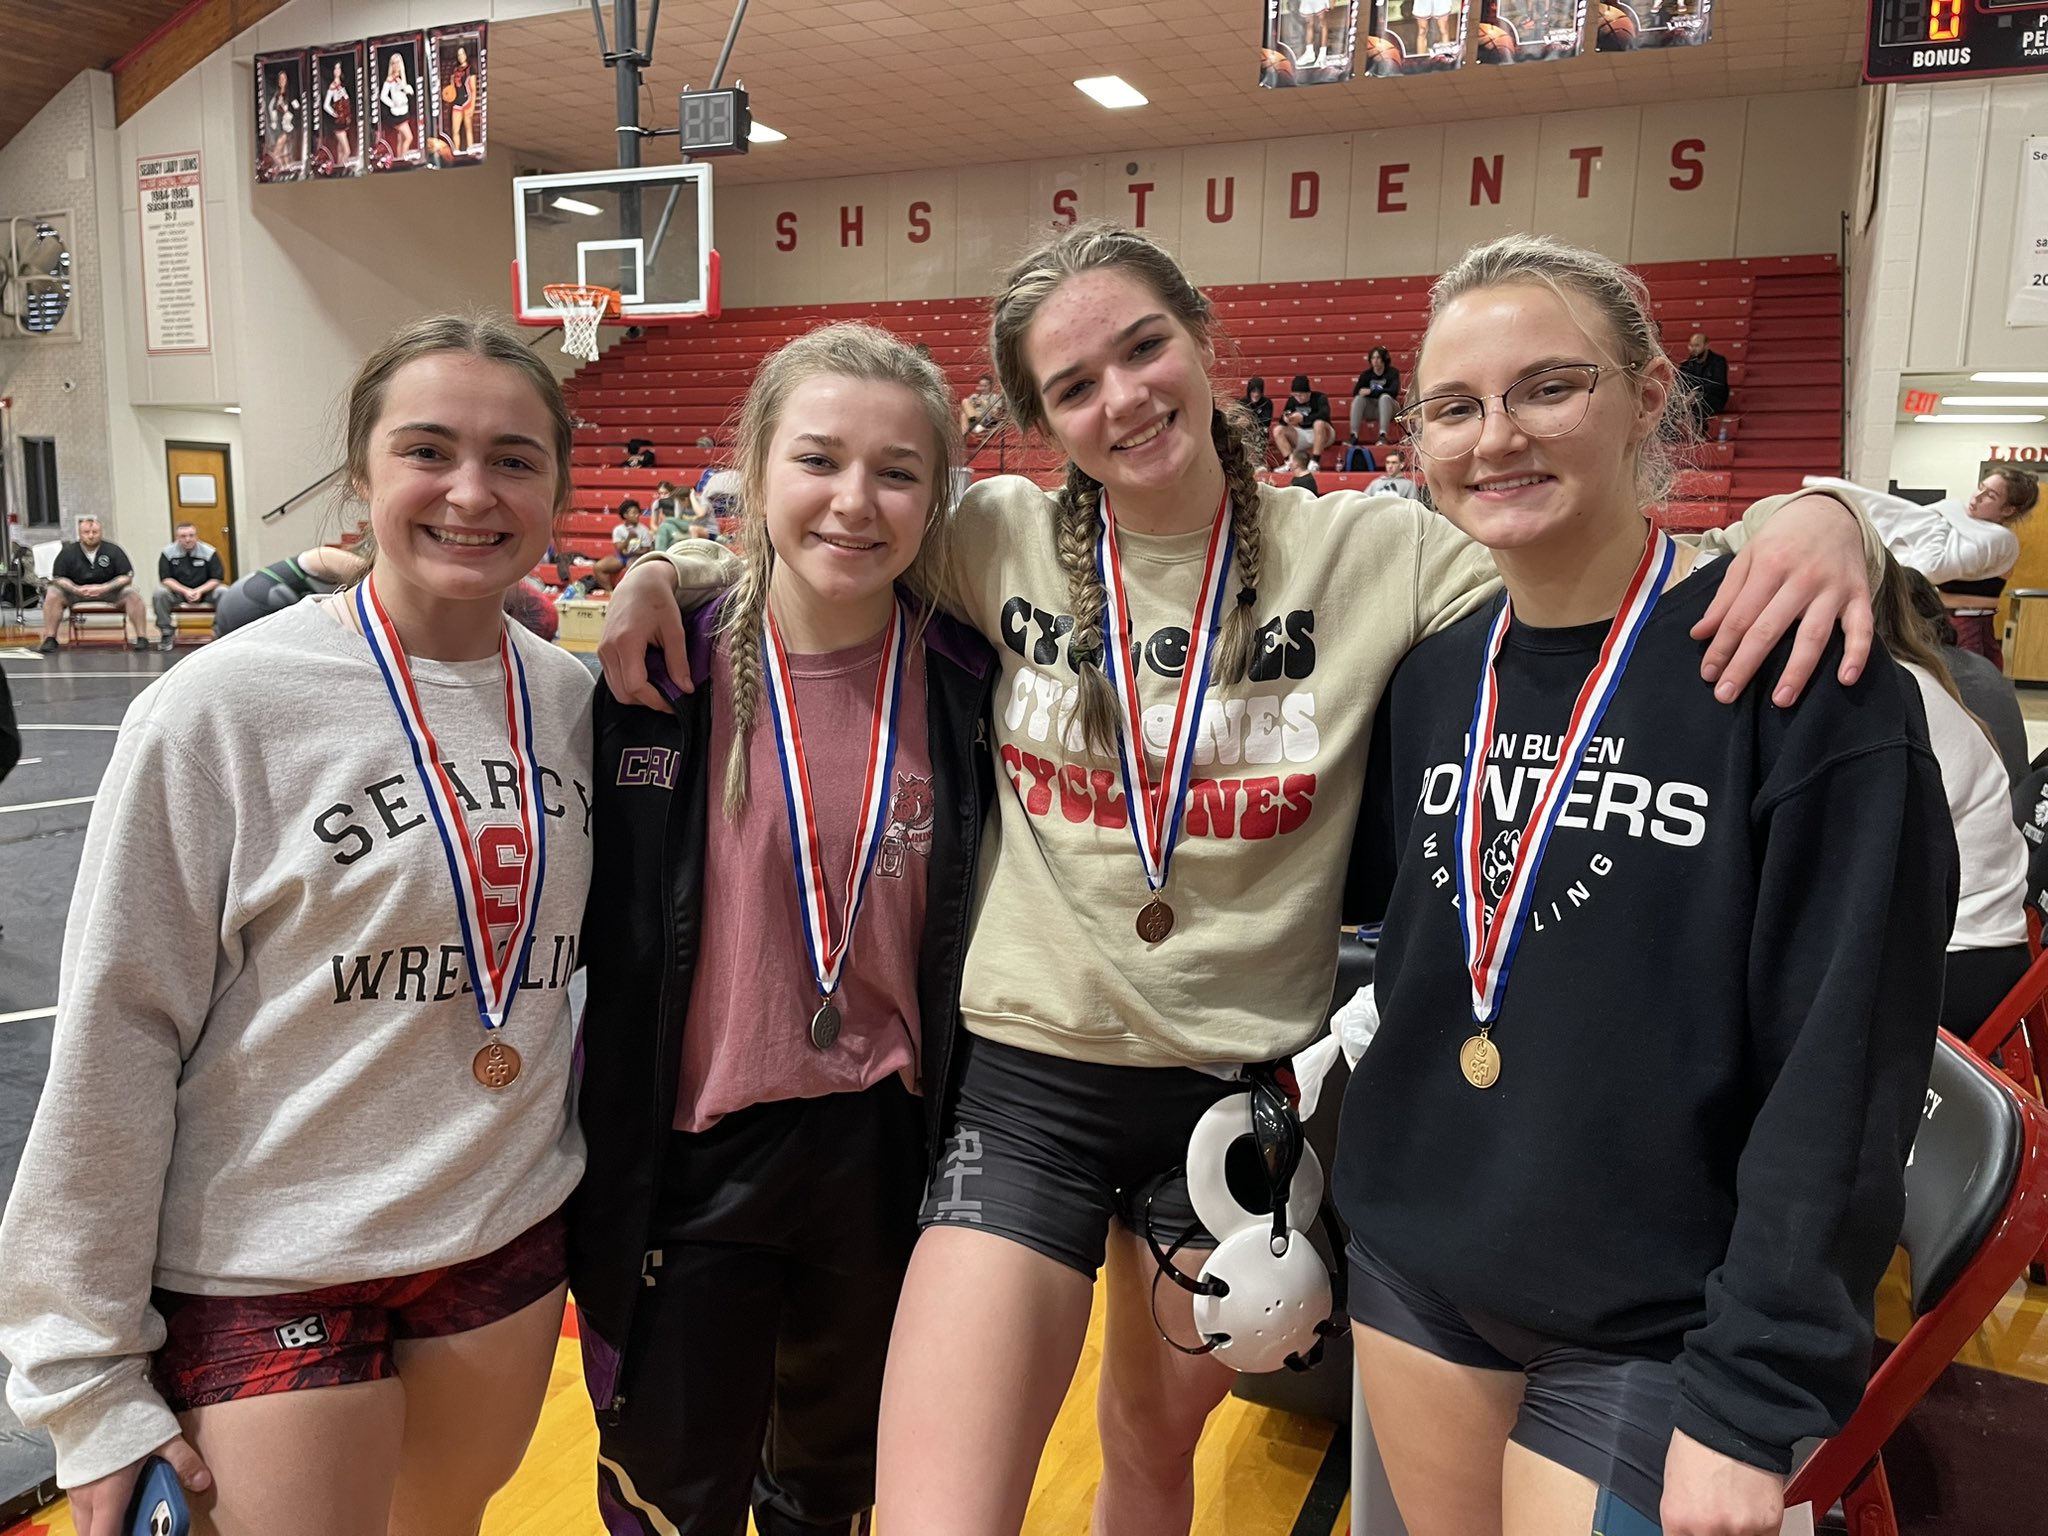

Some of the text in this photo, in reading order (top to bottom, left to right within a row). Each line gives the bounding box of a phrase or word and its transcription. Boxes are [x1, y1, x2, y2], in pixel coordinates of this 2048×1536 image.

[2022, 30, 2048, 49] PE
[1913, 48, 1972, 68] BONUS
[775, 138, 1706, 252] SHS STUDENTS
[1903, 388, 1939, 415] EXIT
[1522, 734, 1625, 765] BUEN
[1001, 744, 1317, 841] CYCLNES
